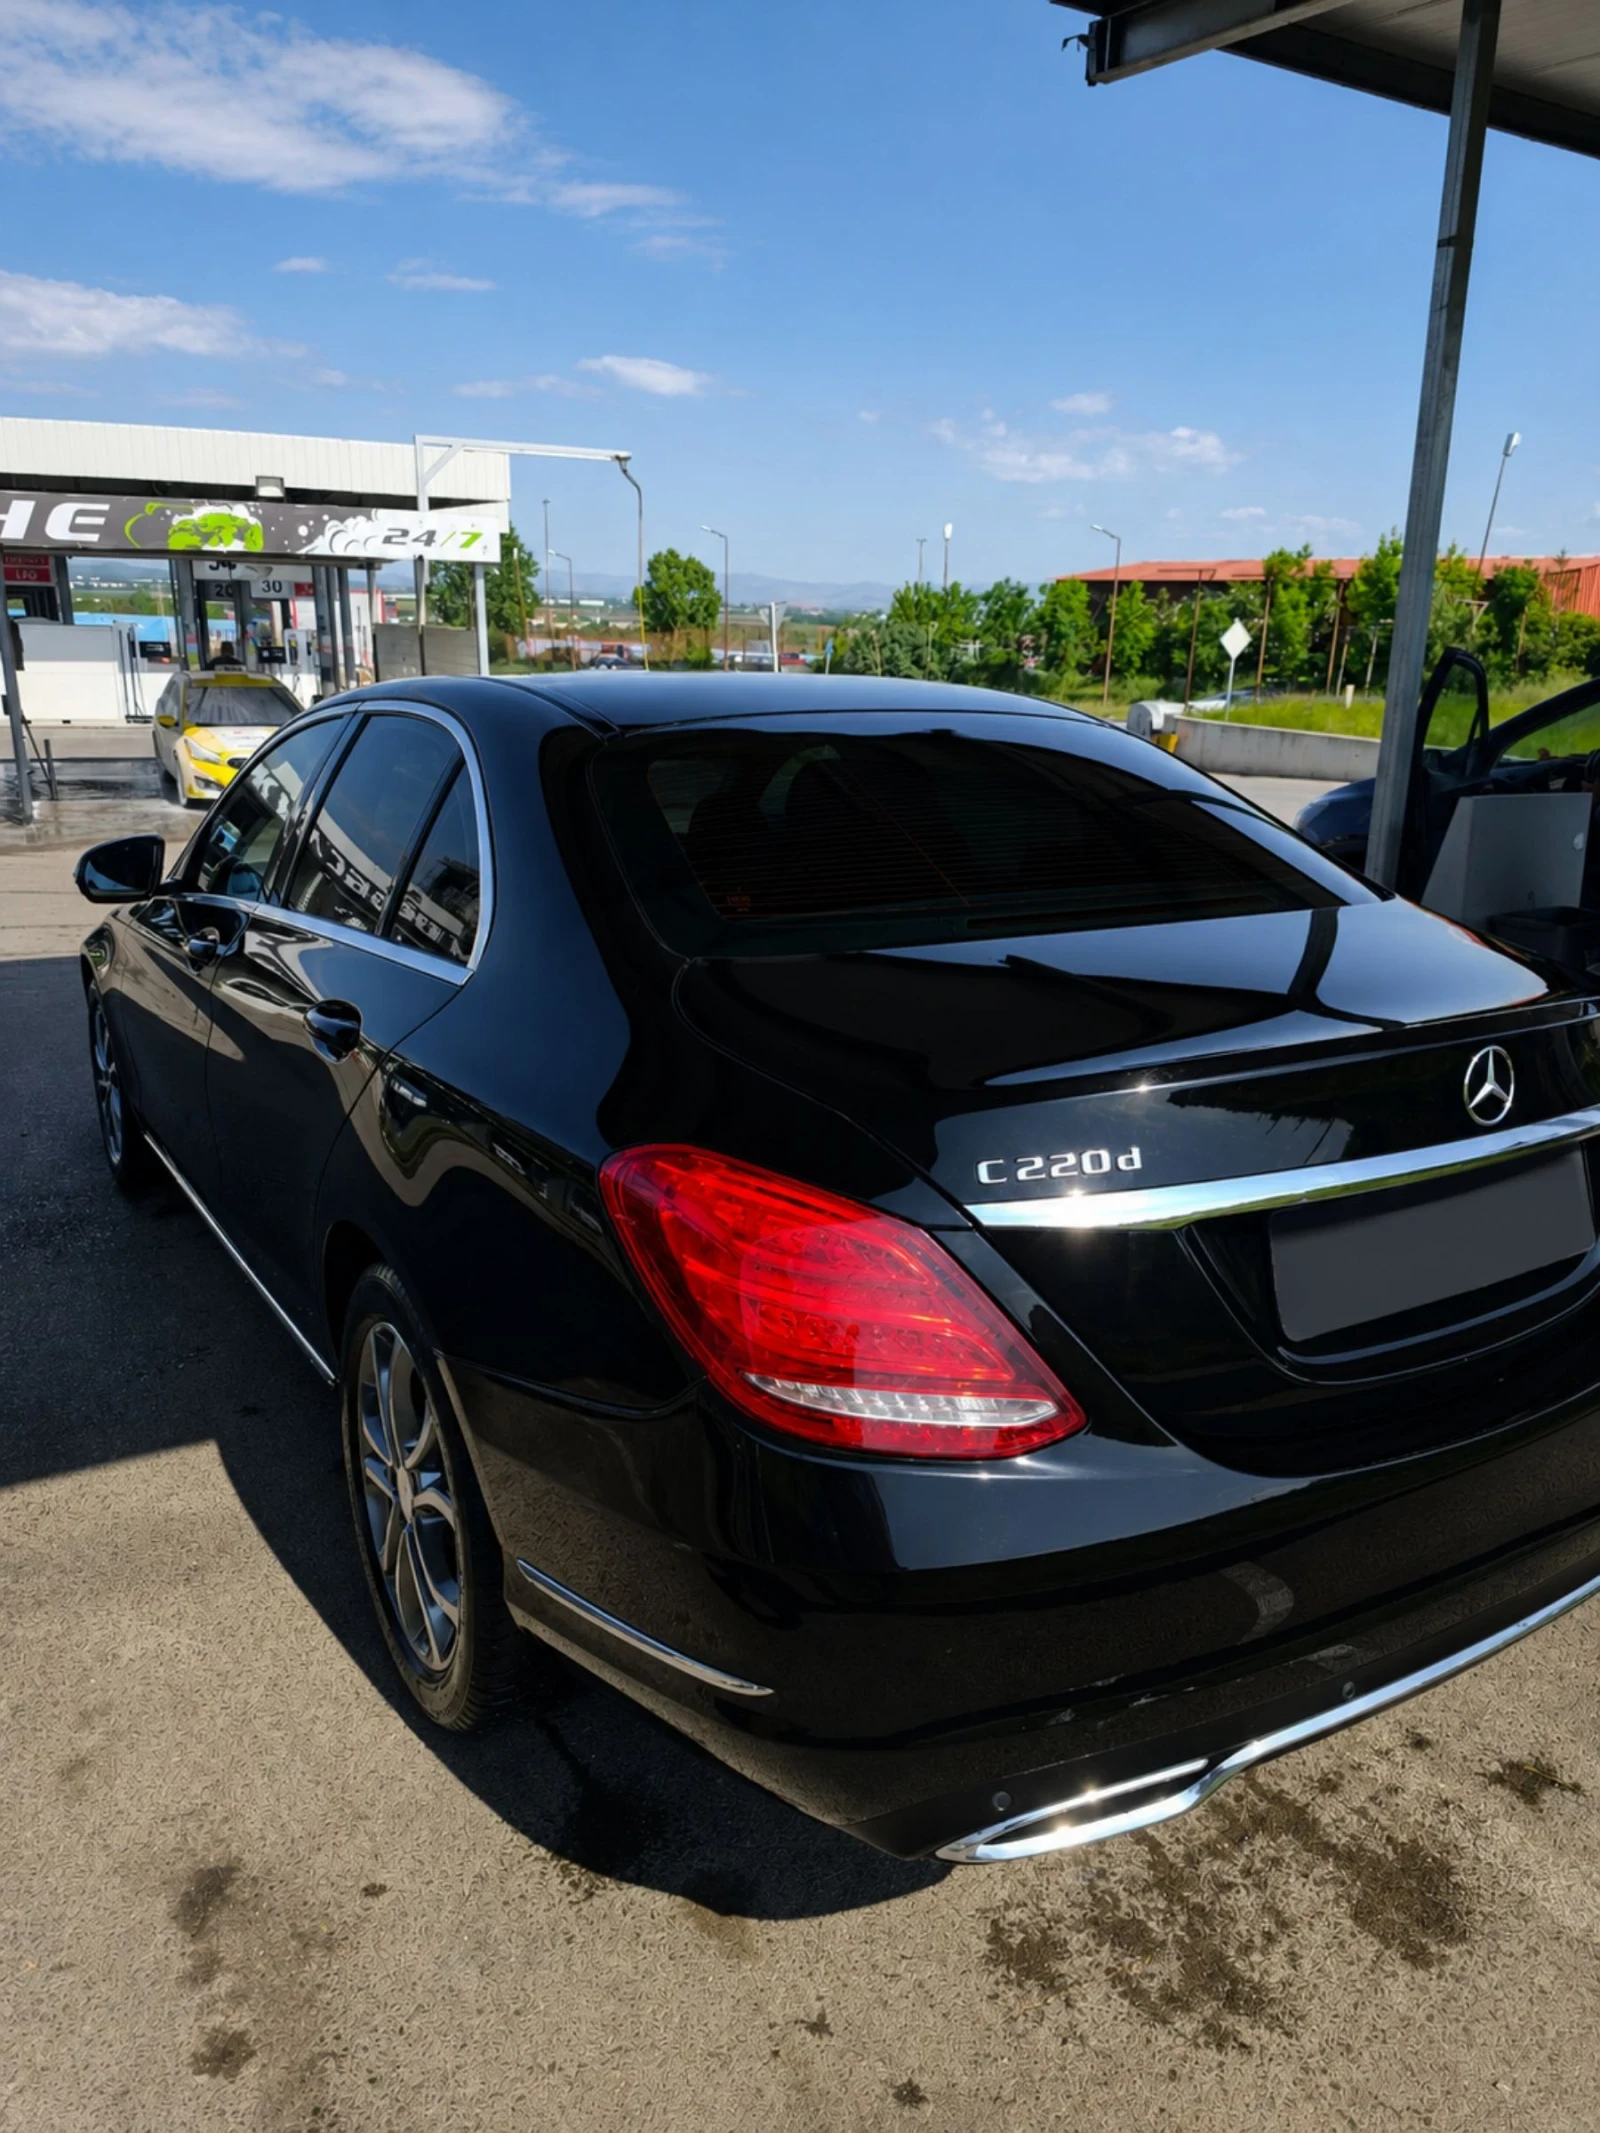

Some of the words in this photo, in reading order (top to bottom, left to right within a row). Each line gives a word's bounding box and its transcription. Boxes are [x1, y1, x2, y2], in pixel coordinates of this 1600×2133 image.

[382, 527, 483, 549] 24/7
[261, 579, 283, 594] 30
[976, 1158, 1008, 1185] C
[1015, 1145, 1143, 1182] 220d
